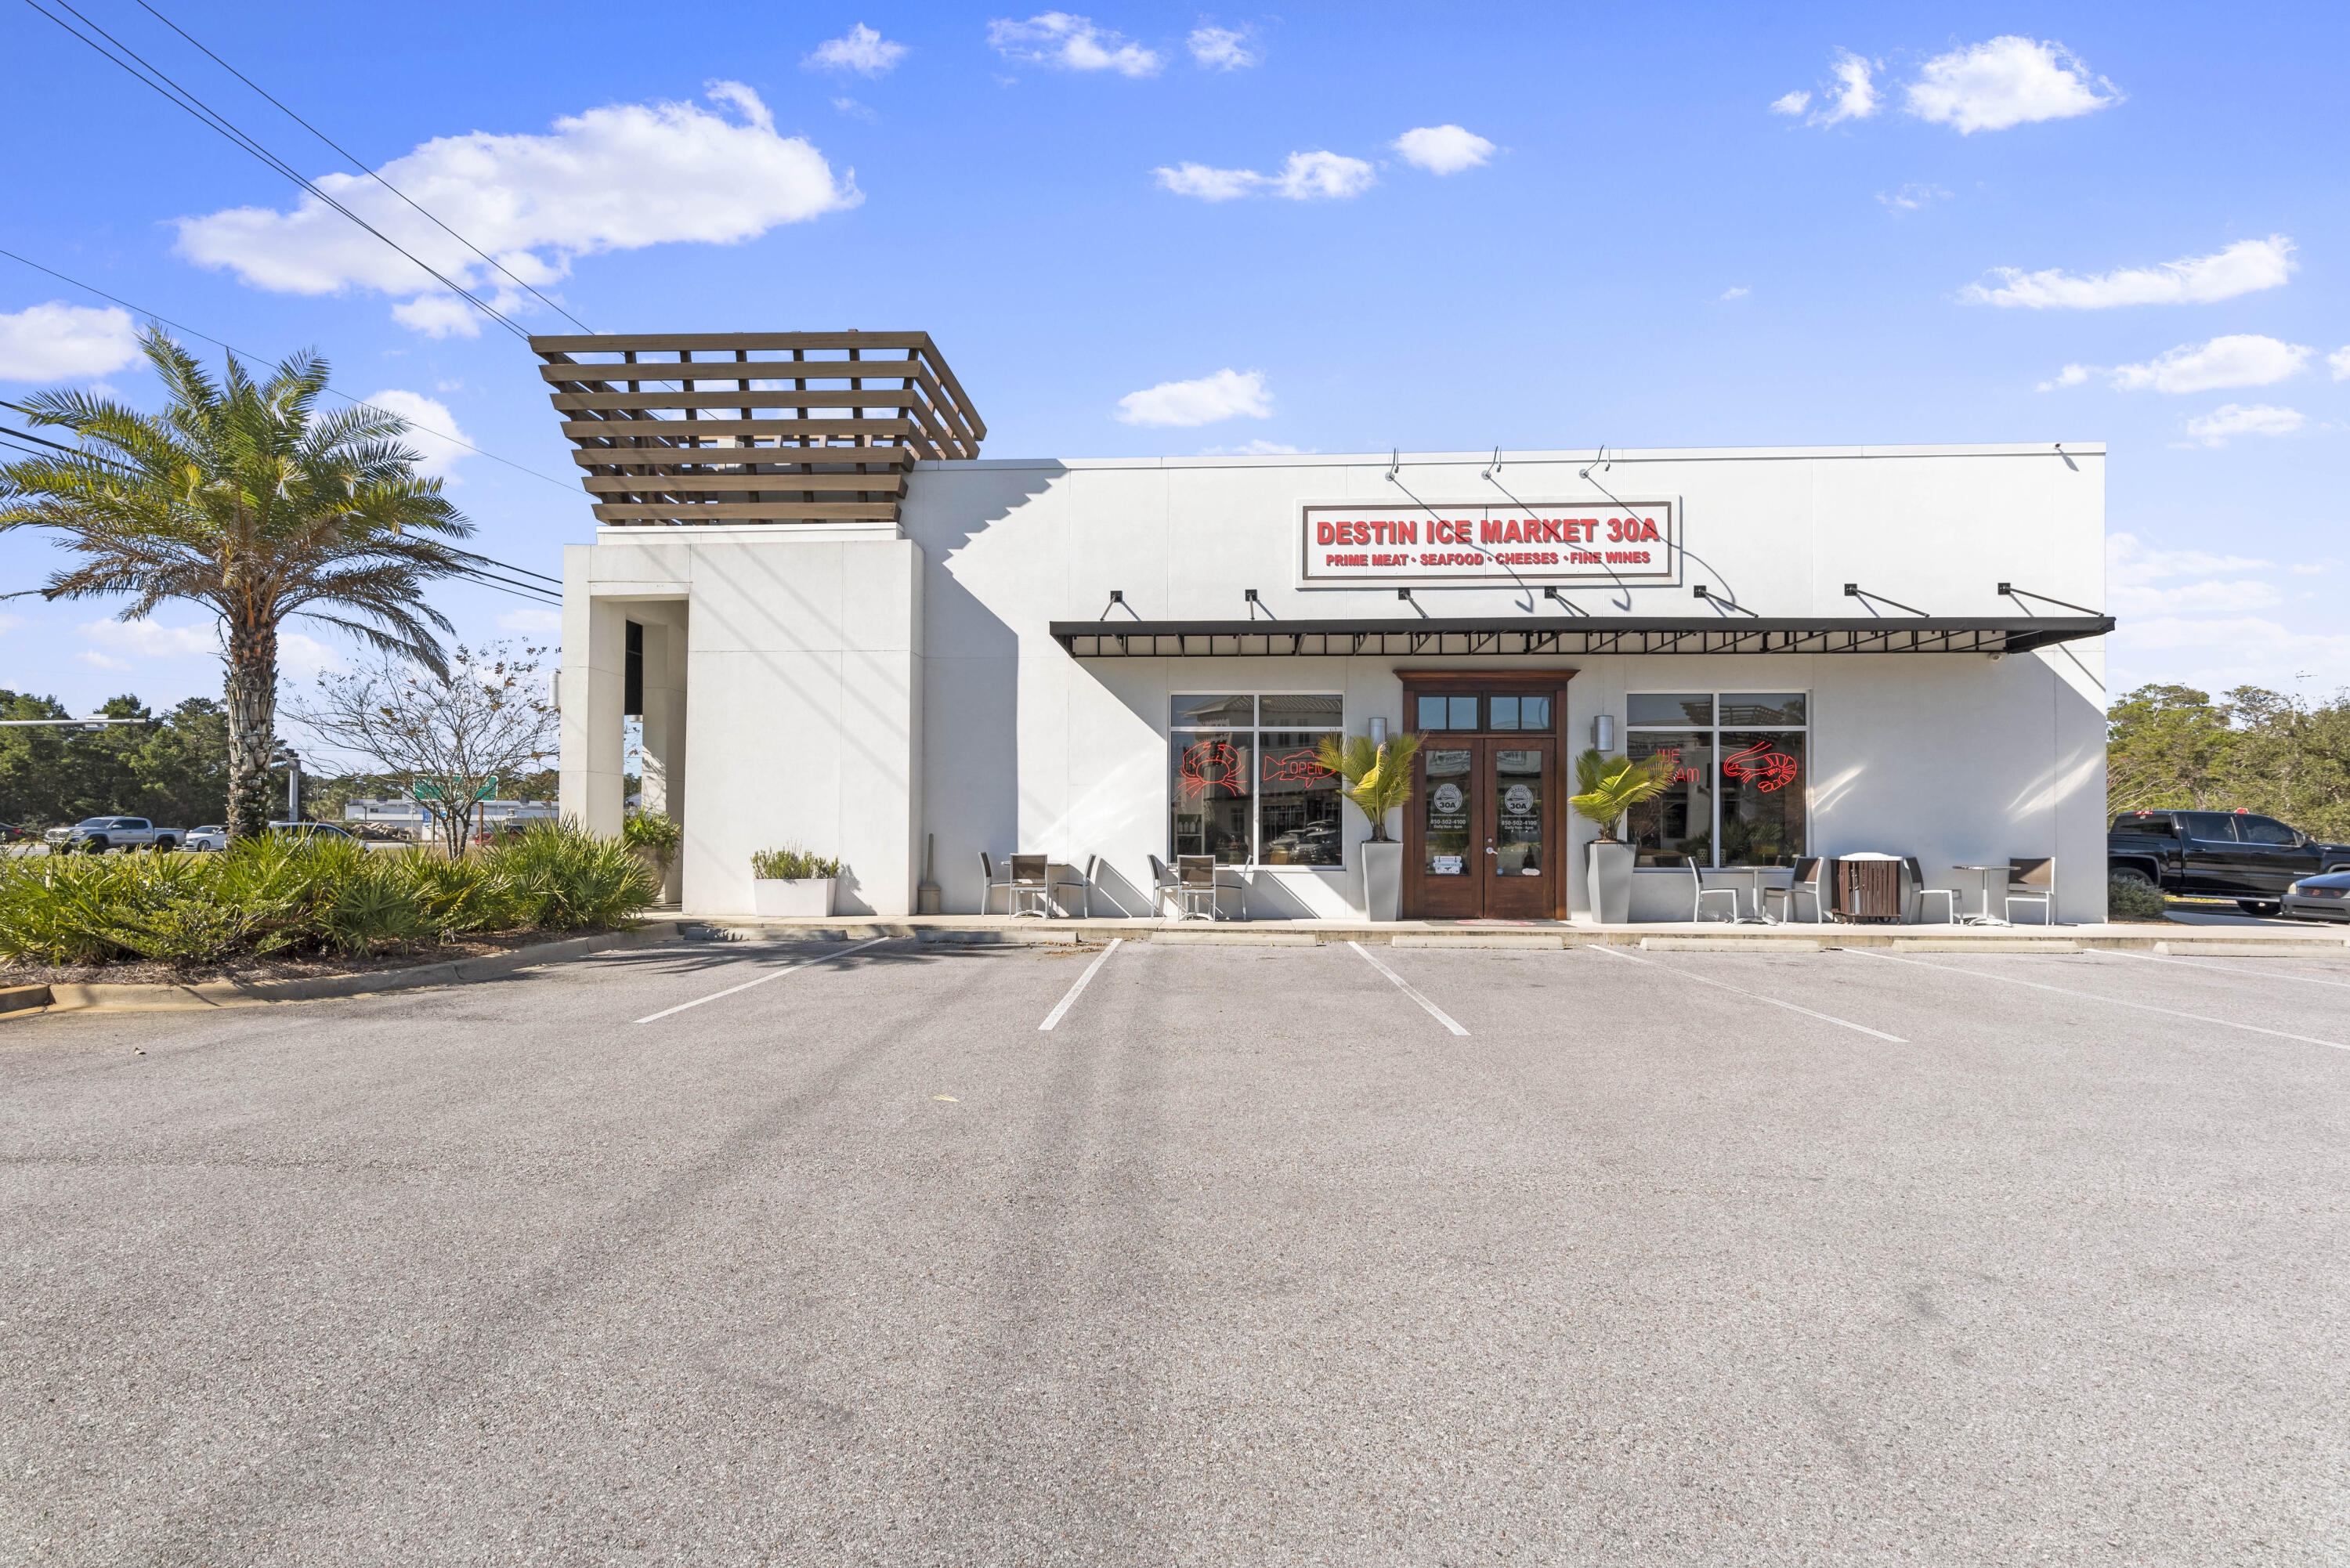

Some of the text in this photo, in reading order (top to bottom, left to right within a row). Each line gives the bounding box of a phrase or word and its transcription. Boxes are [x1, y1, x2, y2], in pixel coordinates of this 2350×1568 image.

[1317, 518, 1661, 545] DESTIN ICE MARKET 30A
[1326, 551, 1651, 566] PRIME MEAT SEAFOOD CHEESES FINE WINES
[1657, 749, 1680, 764] WE
[1290, 761, 1323, 775] OPEN
